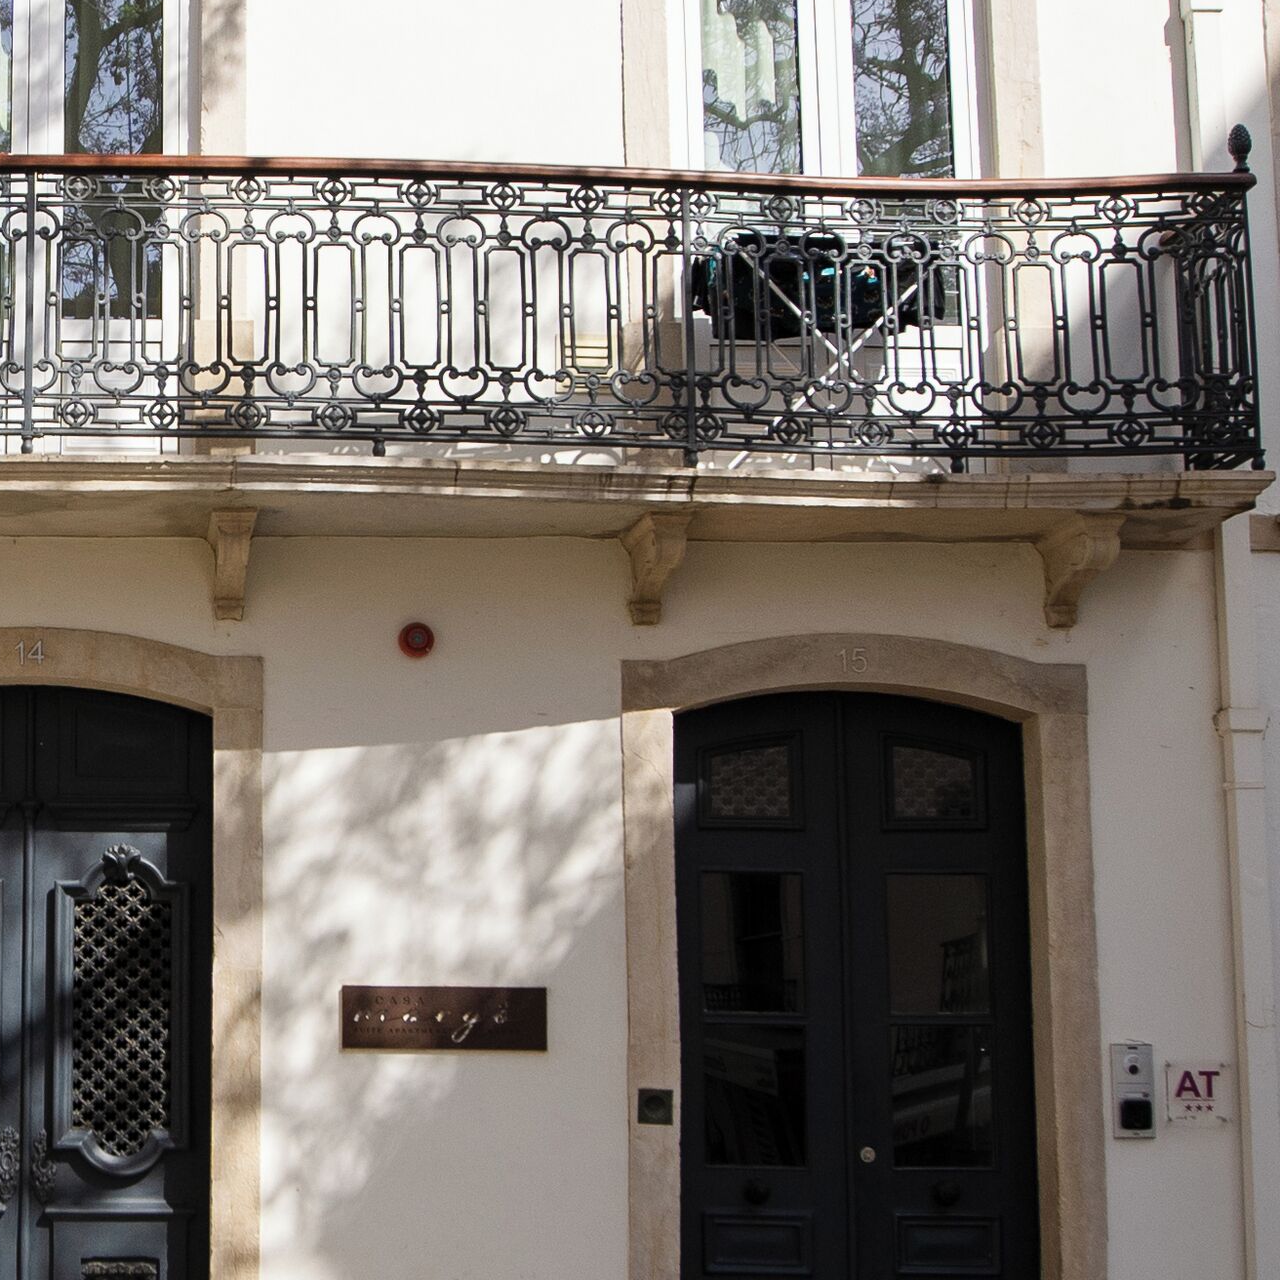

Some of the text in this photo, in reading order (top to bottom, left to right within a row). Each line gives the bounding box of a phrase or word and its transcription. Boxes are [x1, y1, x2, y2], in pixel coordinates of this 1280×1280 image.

[14, 639, 45, 665] 14
[835, 647, 867, 673] 15
[1175, 1070, 1220, 1098] AT
